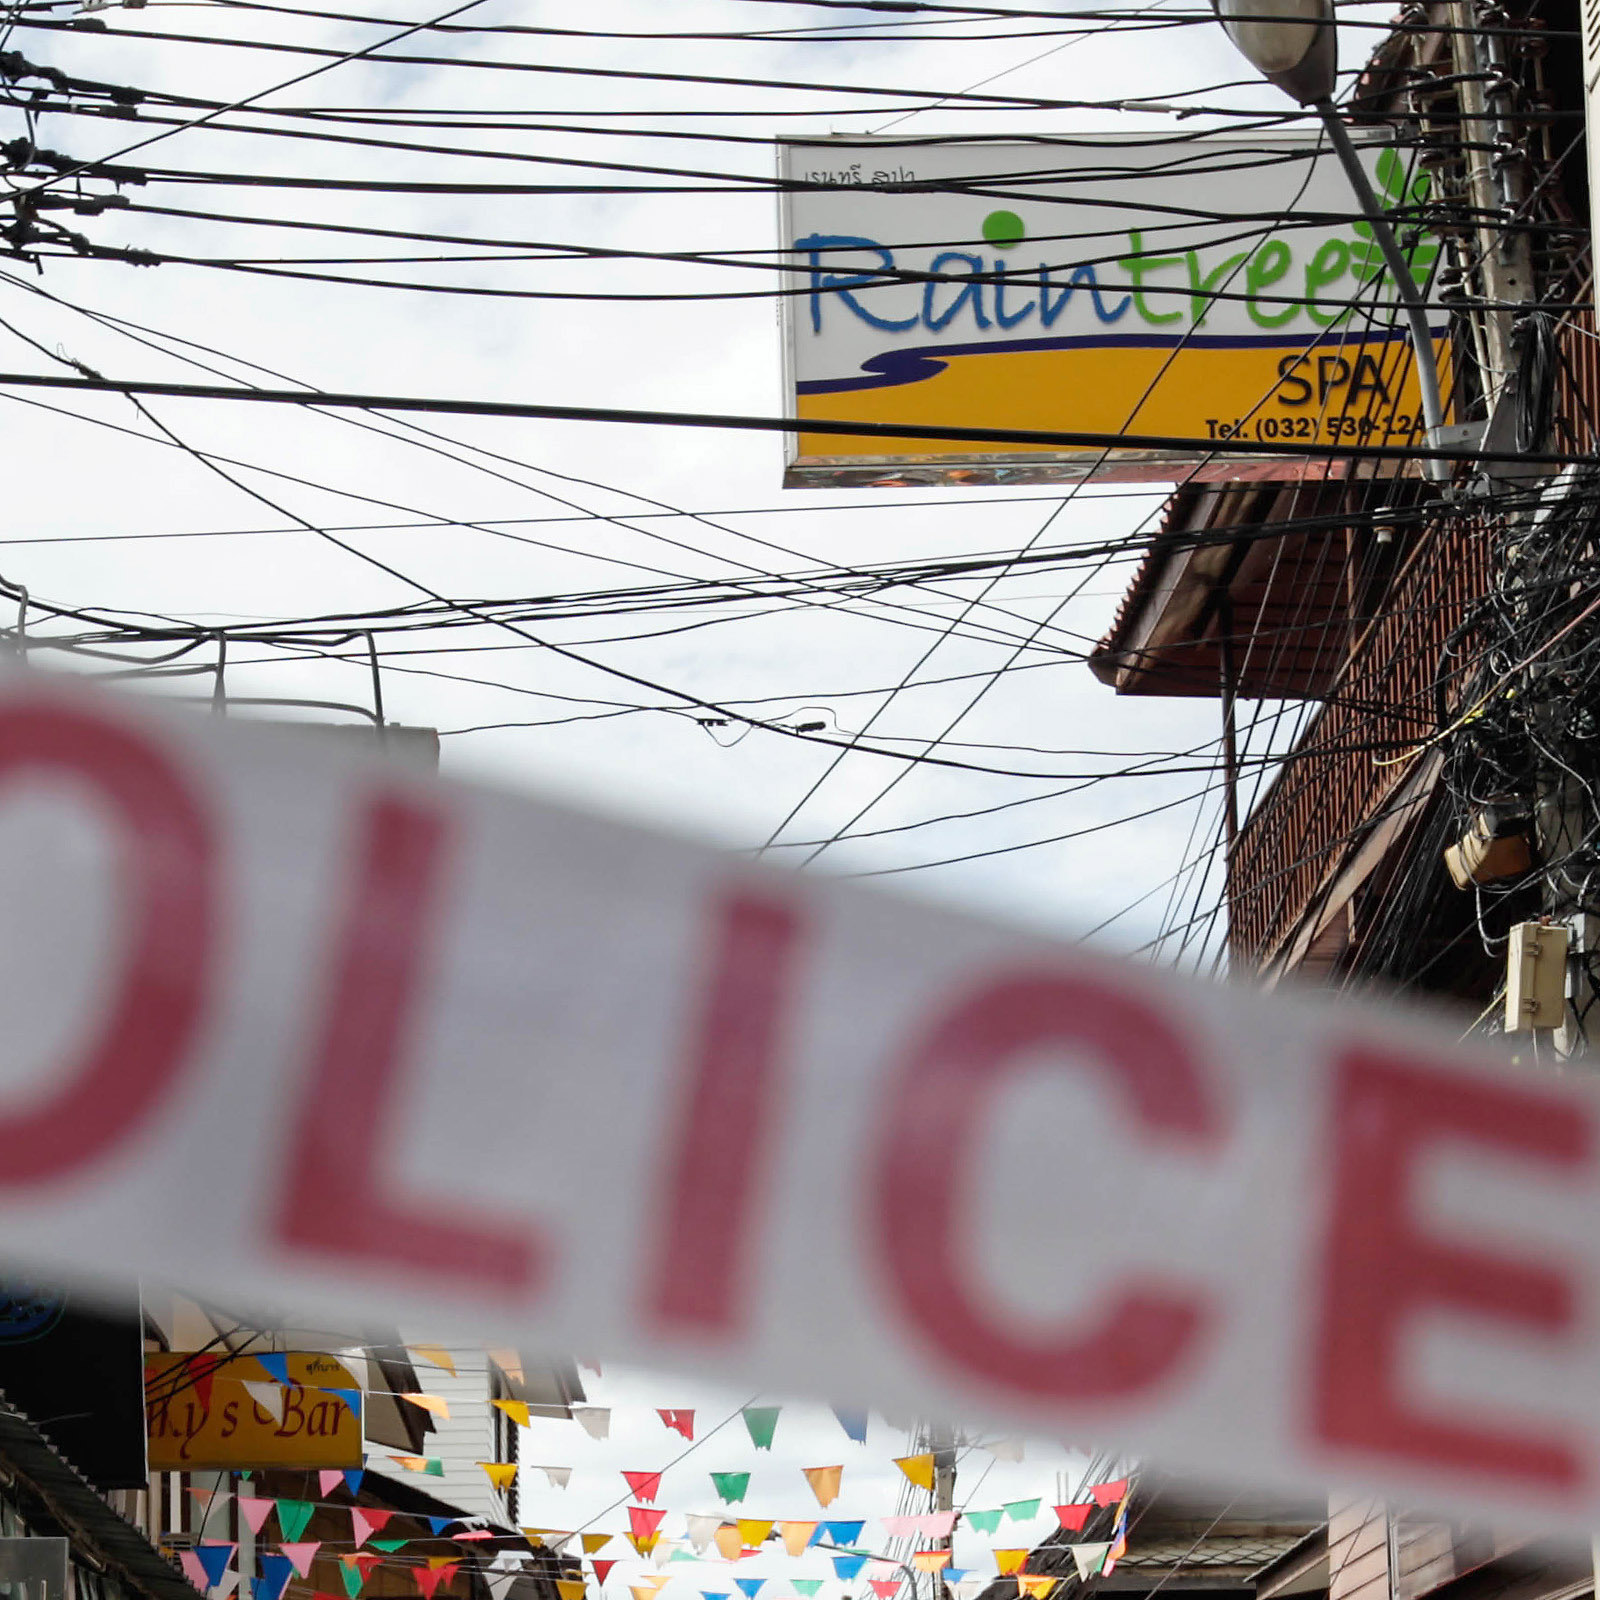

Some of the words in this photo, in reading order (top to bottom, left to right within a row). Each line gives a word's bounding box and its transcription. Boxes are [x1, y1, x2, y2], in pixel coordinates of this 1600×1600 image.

[798, 211, 1357, 335] Raintree
[1277, 354, 1392, 407] SPA
[1205, 419, 1249, 439] Tel.
[1256, 416, 1320, 443] (032)
[253, 1376, 348, 1437] Bar
